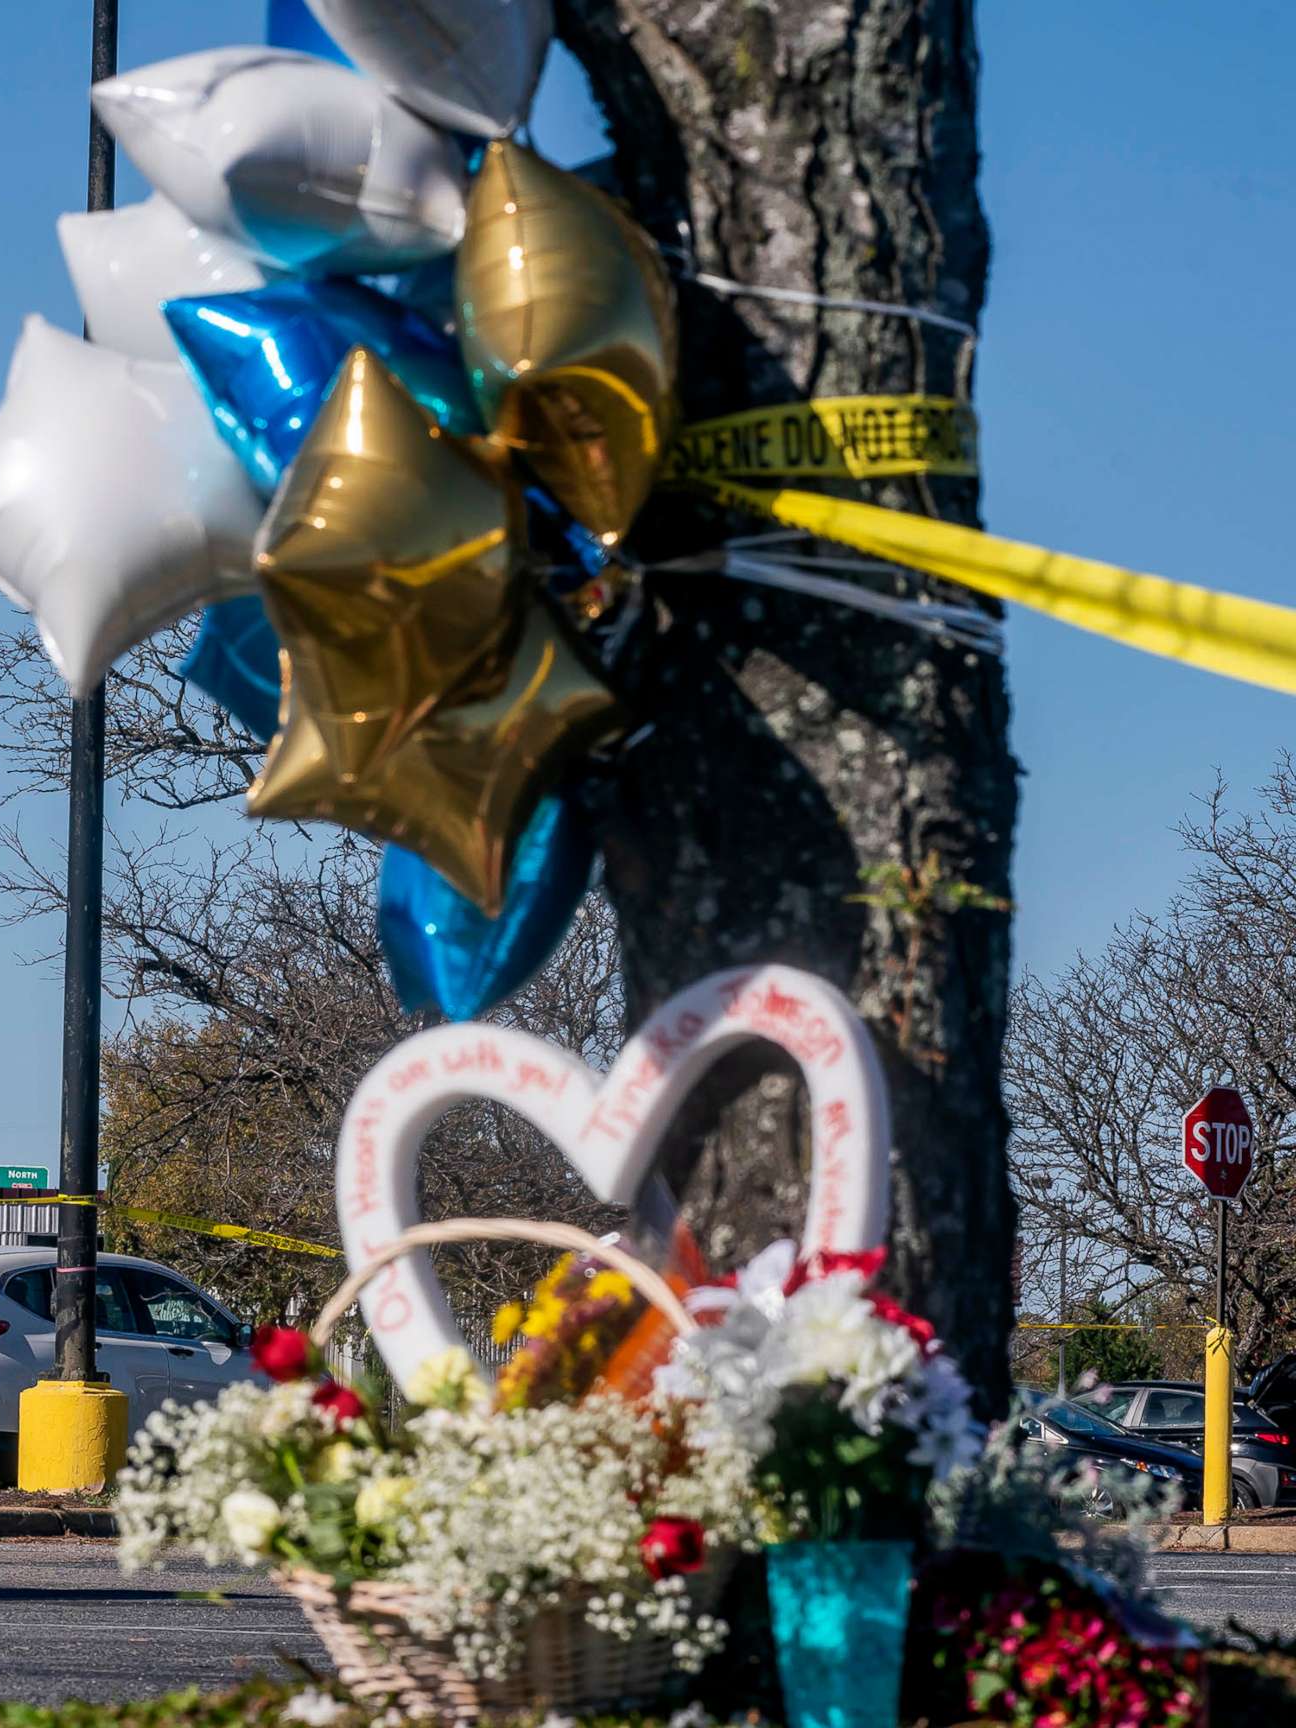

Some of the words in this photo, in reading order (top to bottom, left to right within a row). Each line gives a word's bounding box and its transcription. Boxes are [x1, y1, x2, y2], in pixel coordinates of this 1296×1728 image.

[670, 420, 770, 476] SCENE
[783, 415, 827, 467] DO
[839, 408, 904, 462] NOT
[1190, 1120, 1251, 1165] STOP
[8, 1169, 38, 1180] NORTH
